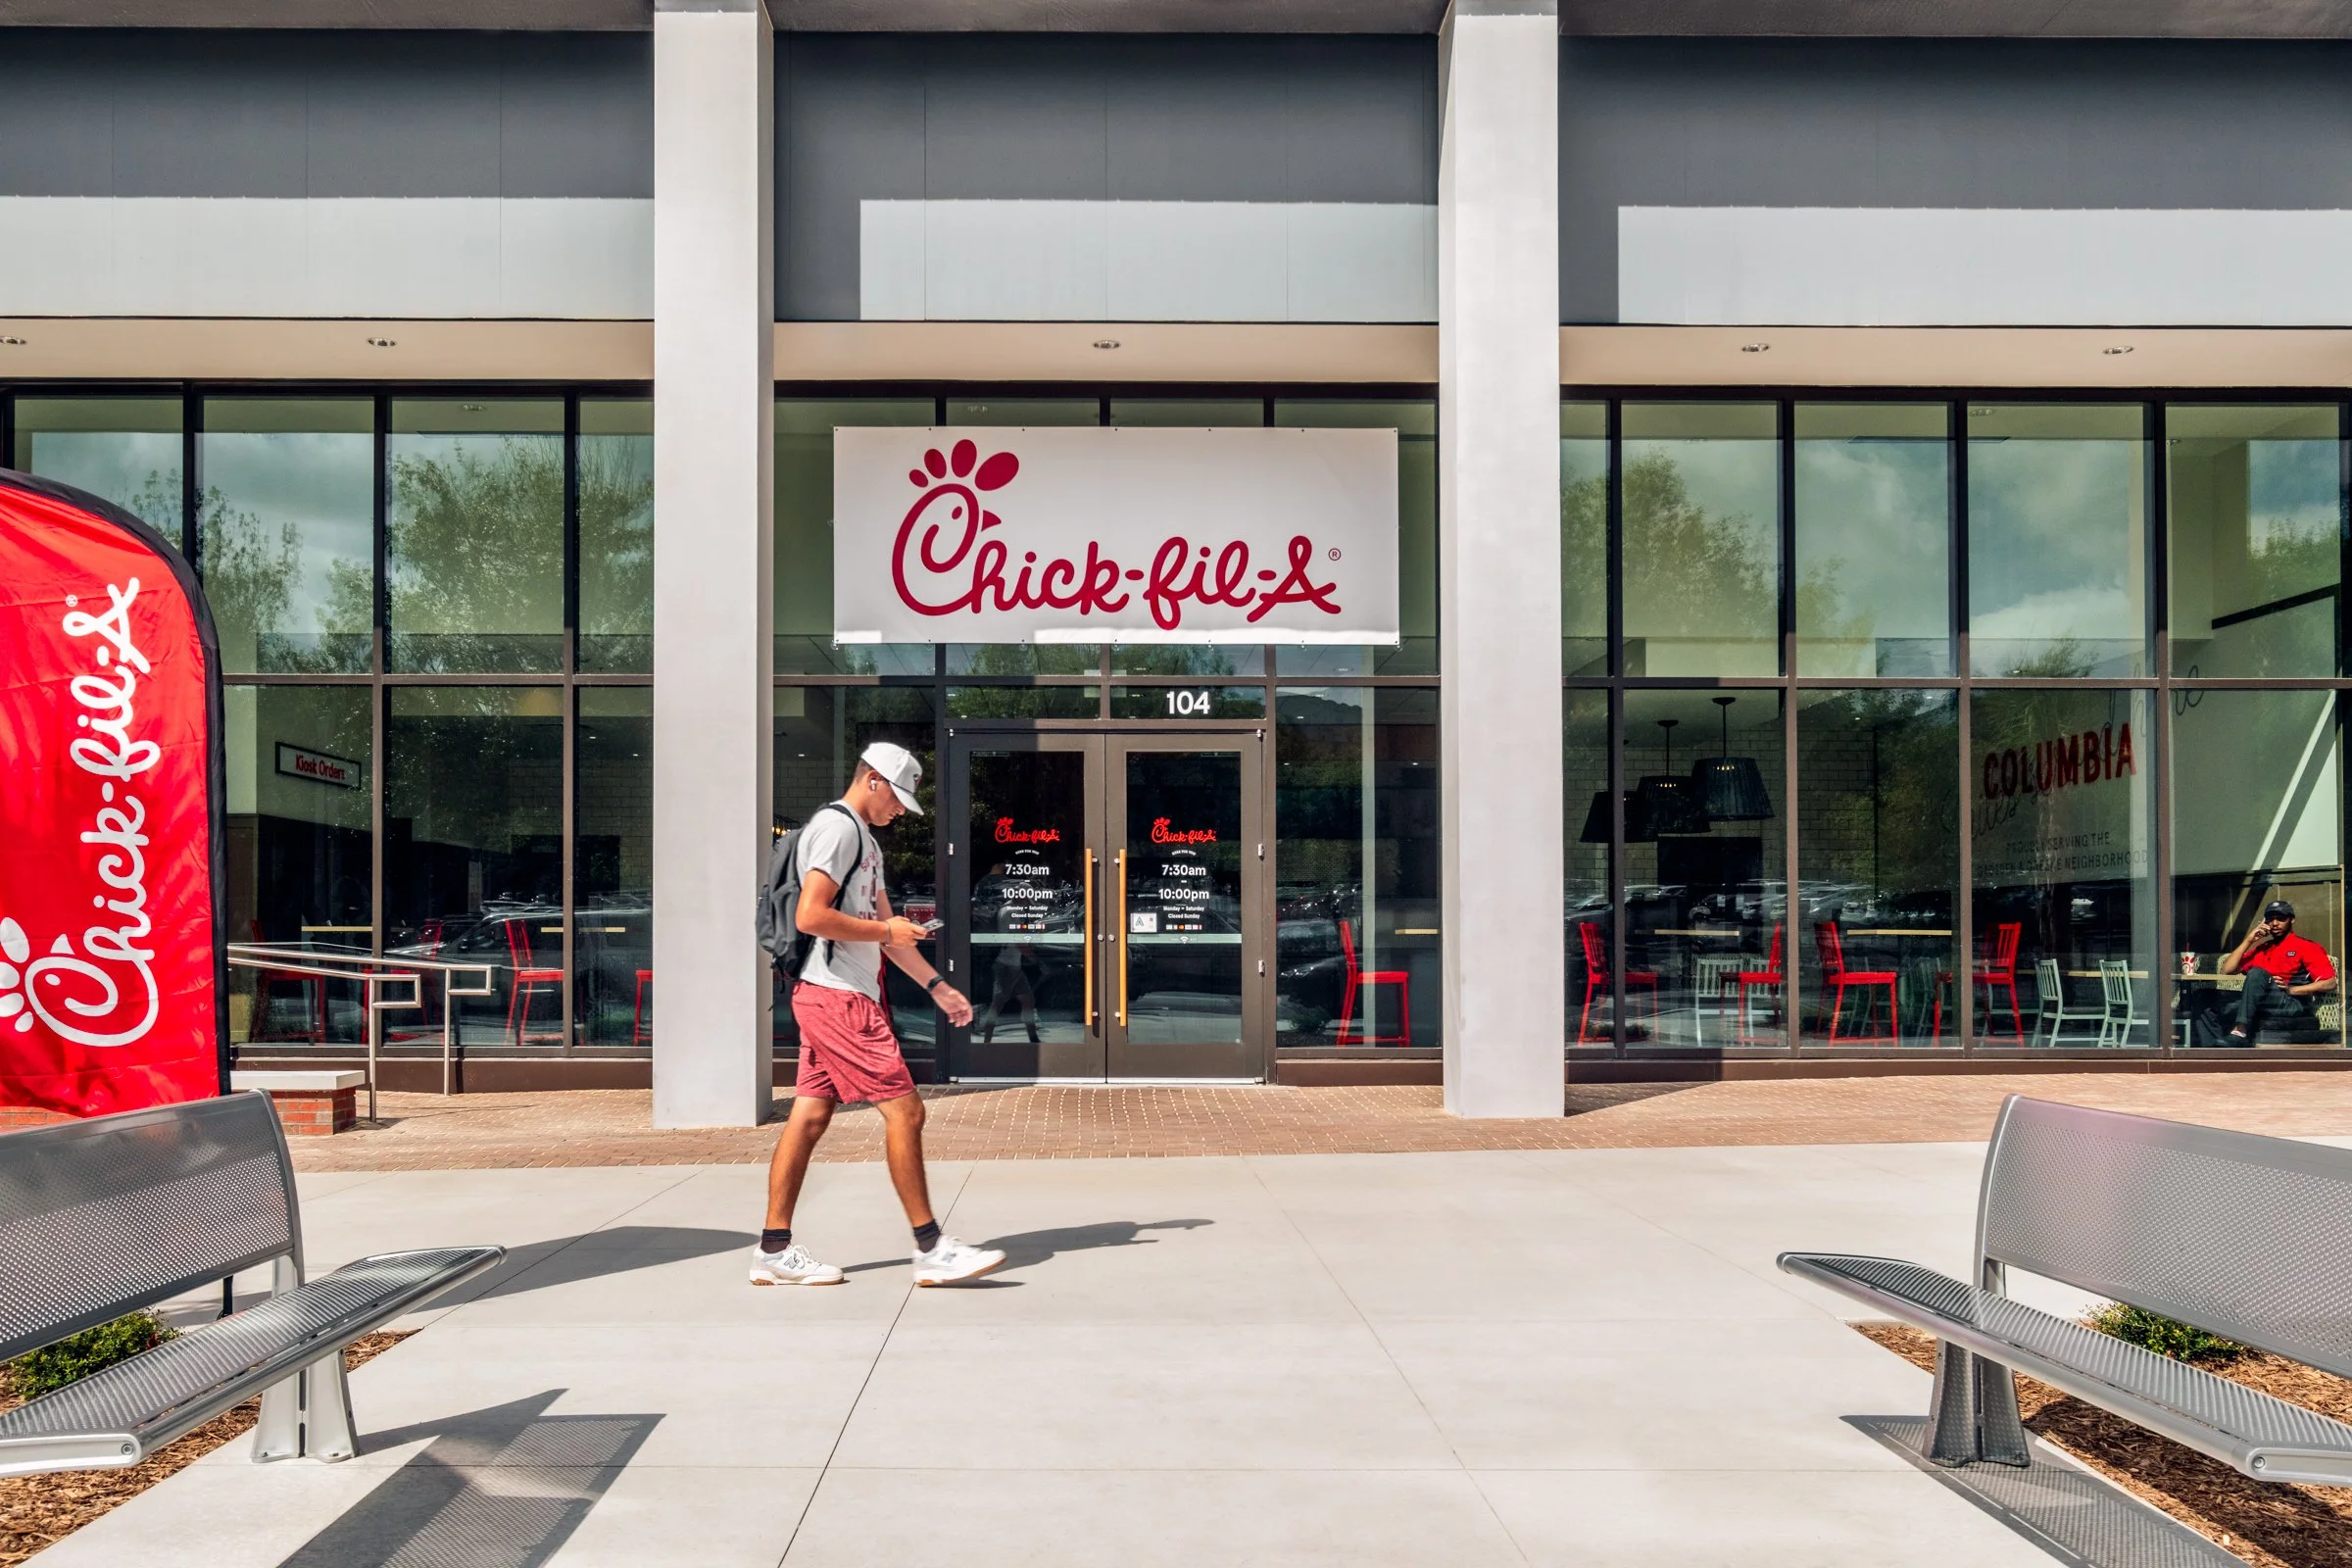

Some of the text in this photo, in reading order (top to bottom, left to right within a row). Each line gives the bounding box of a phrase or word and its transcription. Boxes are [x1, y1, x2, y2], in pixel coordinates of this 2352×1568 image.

[1166, 691, 1211, 715] 104
[295, 754, 346, 781] Kiosk Orders
[1984, 722, 2137, 800] COLUMBIA
[2047, 835, 2088, 851] SERVING
[2091, 831, 2110, 846] THE
[1005, 863, 1050, 875] 7:30am
[1162, 863, 1206, 875] 7:30am
[2065, 850, 2148, 870] NEIGHBORHOOD
[1002, 888, 1054, 901] 10:00pm
[1158, 888, 1210, 901] 10:00pm
